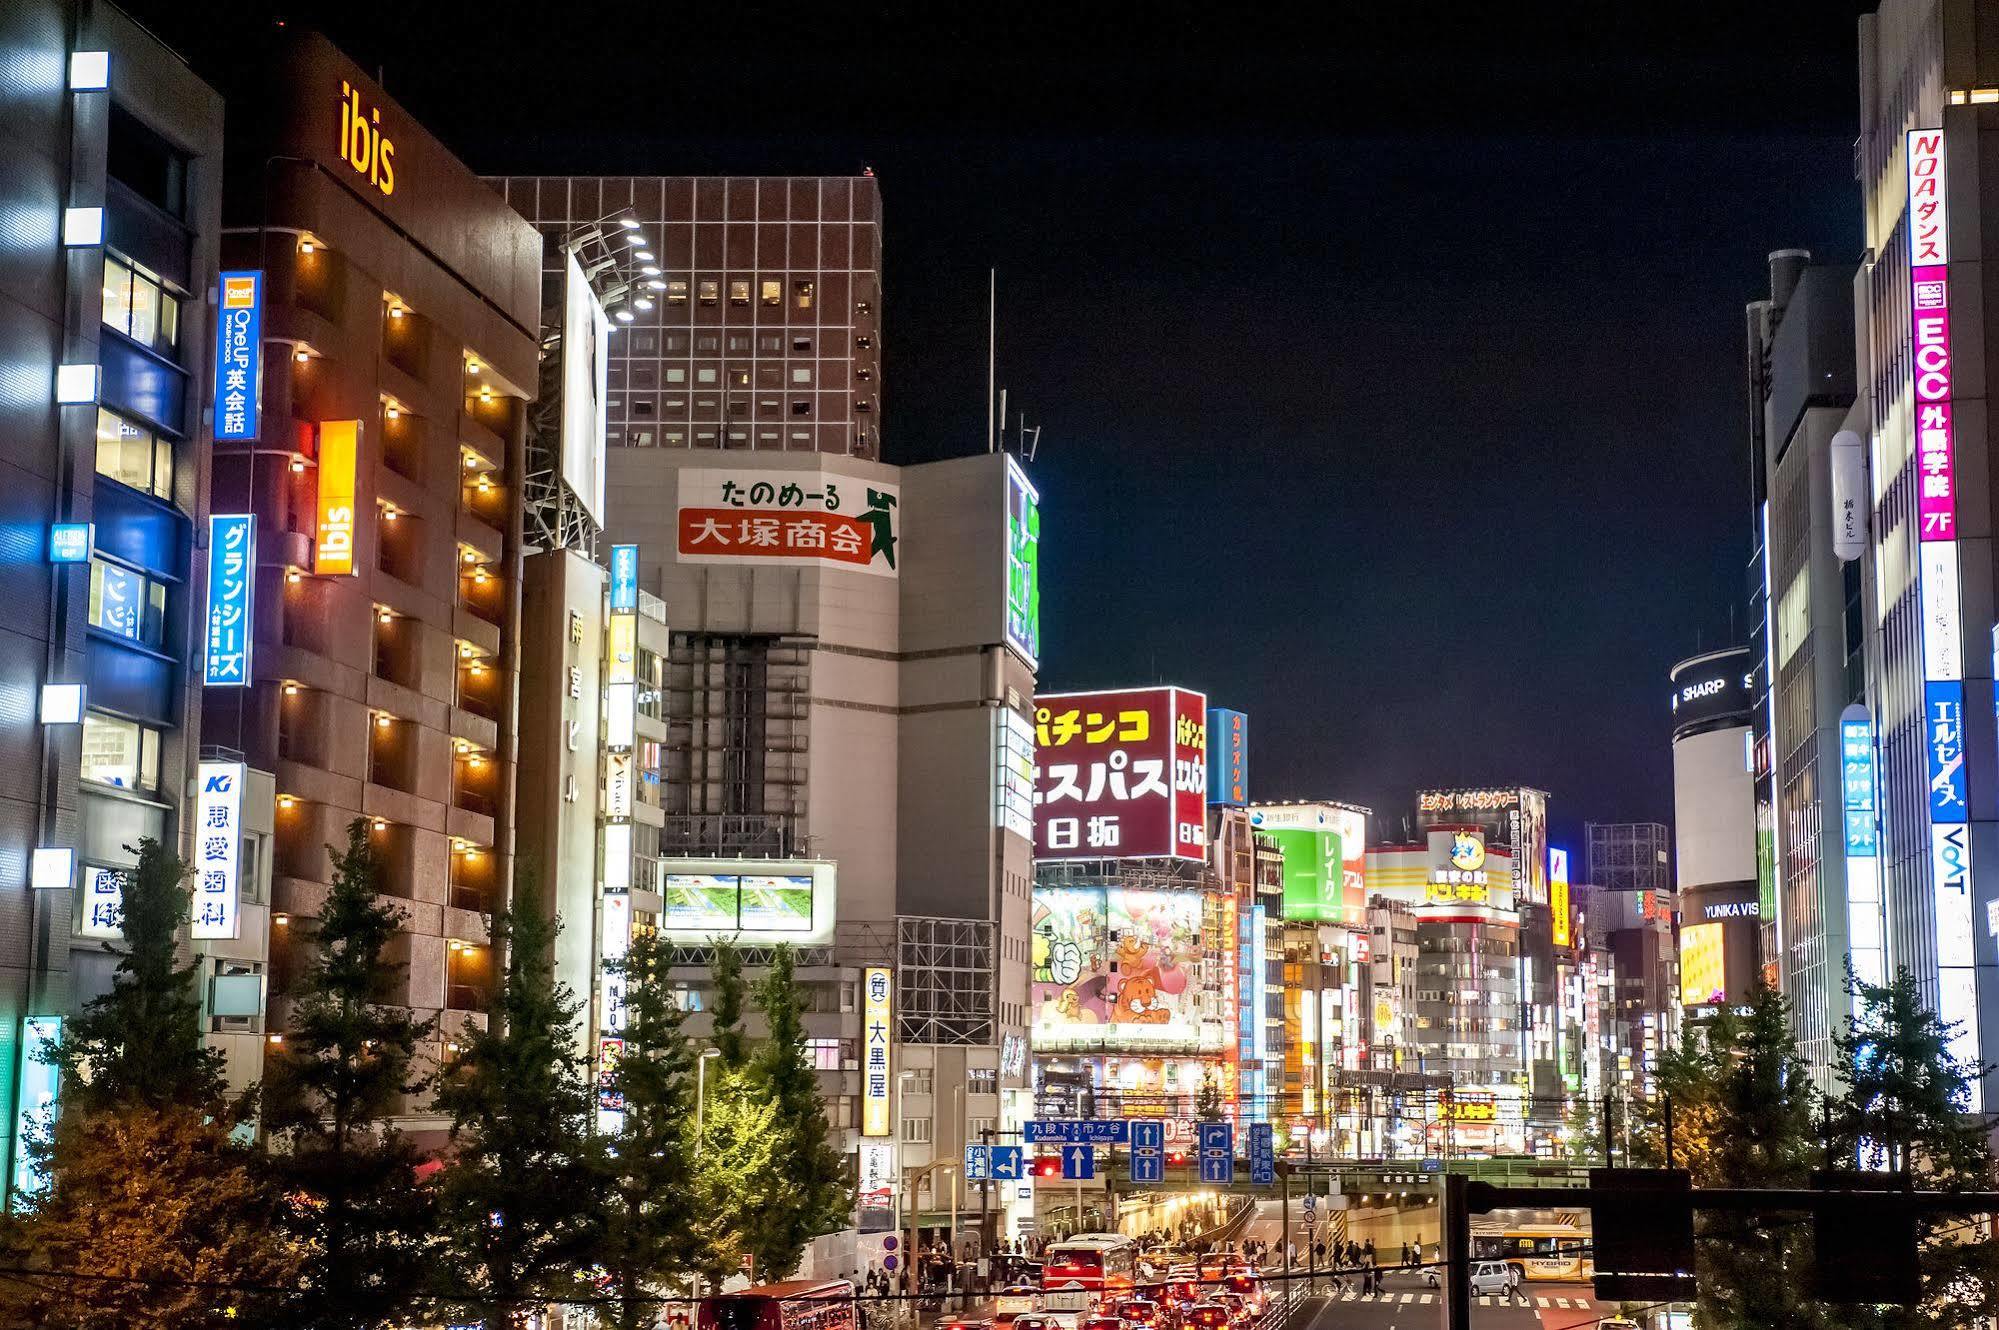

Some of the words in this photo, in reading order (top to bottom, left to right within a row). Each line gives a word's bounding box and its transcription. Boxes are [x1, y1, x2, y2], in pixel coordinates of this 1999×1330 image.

[340, 80, 396, 196] ibis
[1914, 136, 1941, 259] NOAダンス
[224, 369, 247, 434] 英会話
[721, 480, 840, 511] たのめーる
[320, 507, 350, 561] ibis
[690, 517, 863, 555] 大塚商会
[1925, 512, 1952, 532] 7F
[220, 523, 247, 677] グランシーズ
[1683, 678, 1725, 701] SHARP
[1034, 707, 1150, 747] パチンコ
[1048, 816, 1120, 849] 日拓
[1324, 835, 1335, 901] レイク
[1705, 903, 1740, 918] YUNIKA
[870, 977, 886, 998] 質
[868, 1021, 886, 1098] 大黒屋
[1031, 1123, 1070, 1134] 九段下
